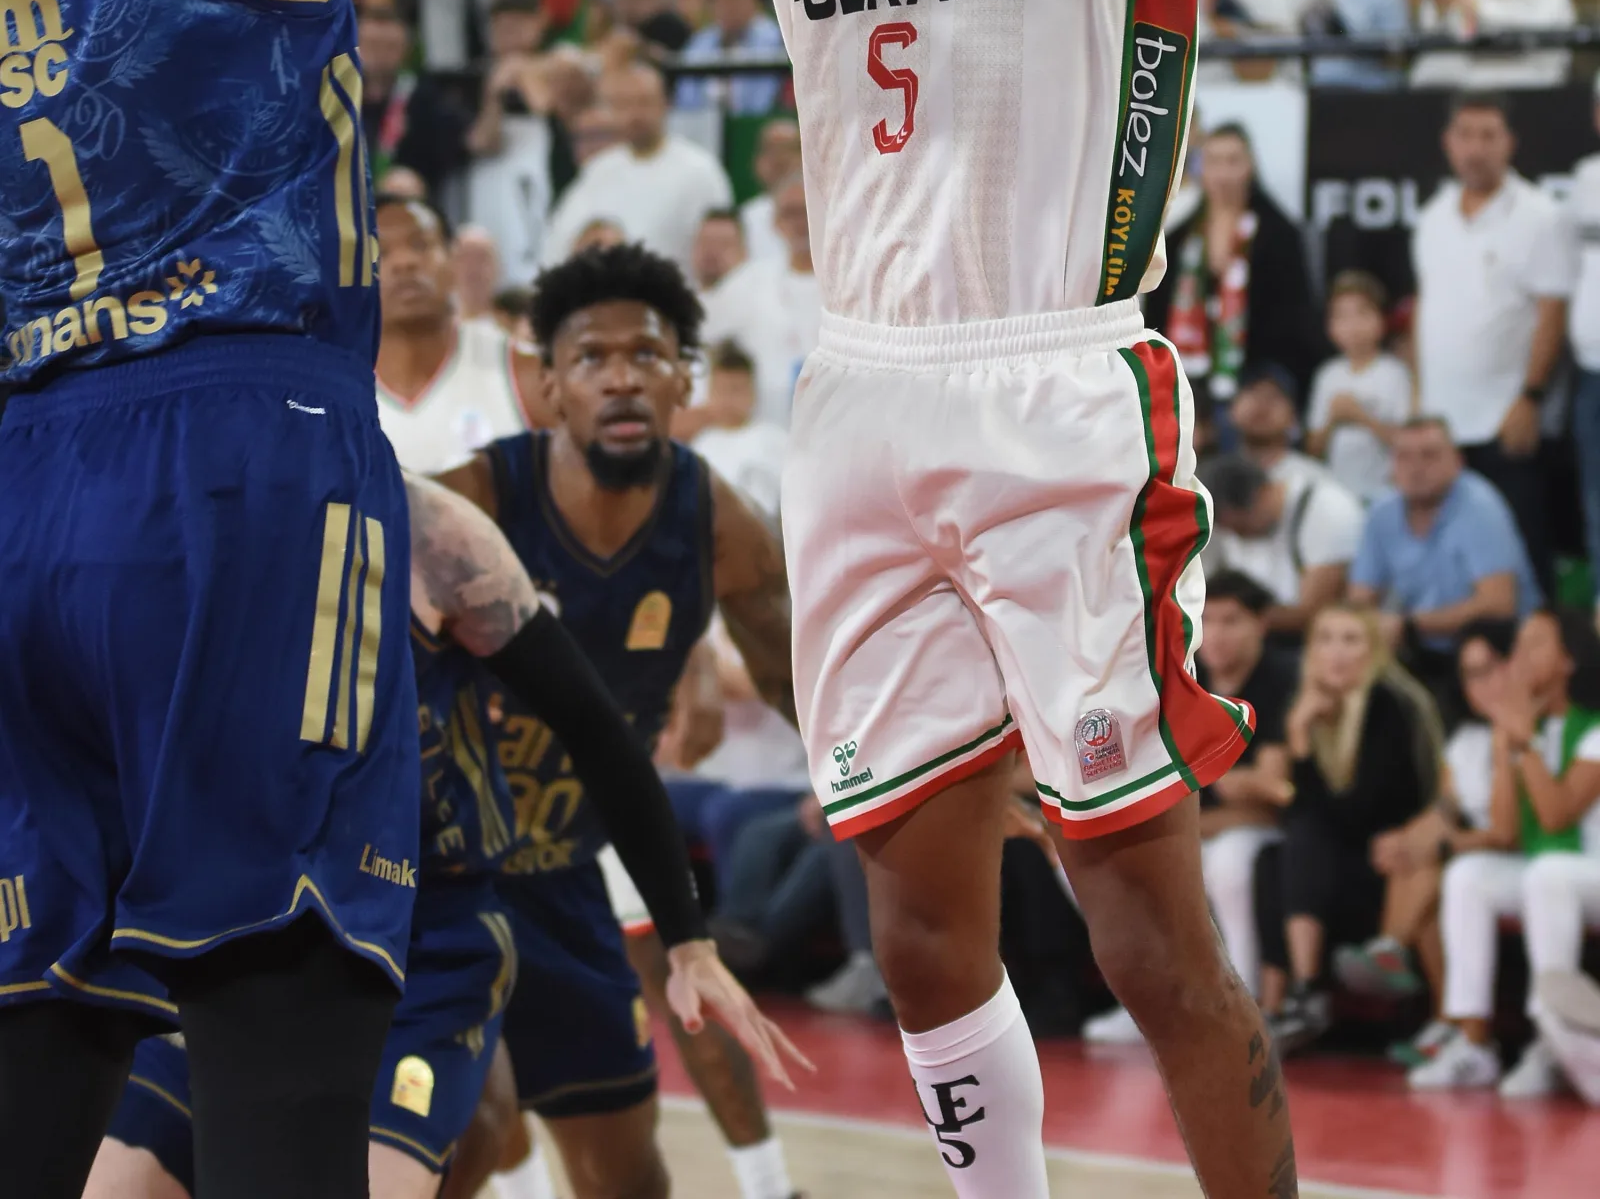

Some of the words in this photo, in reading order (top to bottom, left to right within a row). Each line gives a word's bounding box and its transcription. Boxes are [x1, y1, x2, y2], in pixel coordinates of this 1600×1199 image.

[19, 116, 105, 301] 1
[830, 766, 874, 794] hummel
[359, 843, 417, 888] Limak
